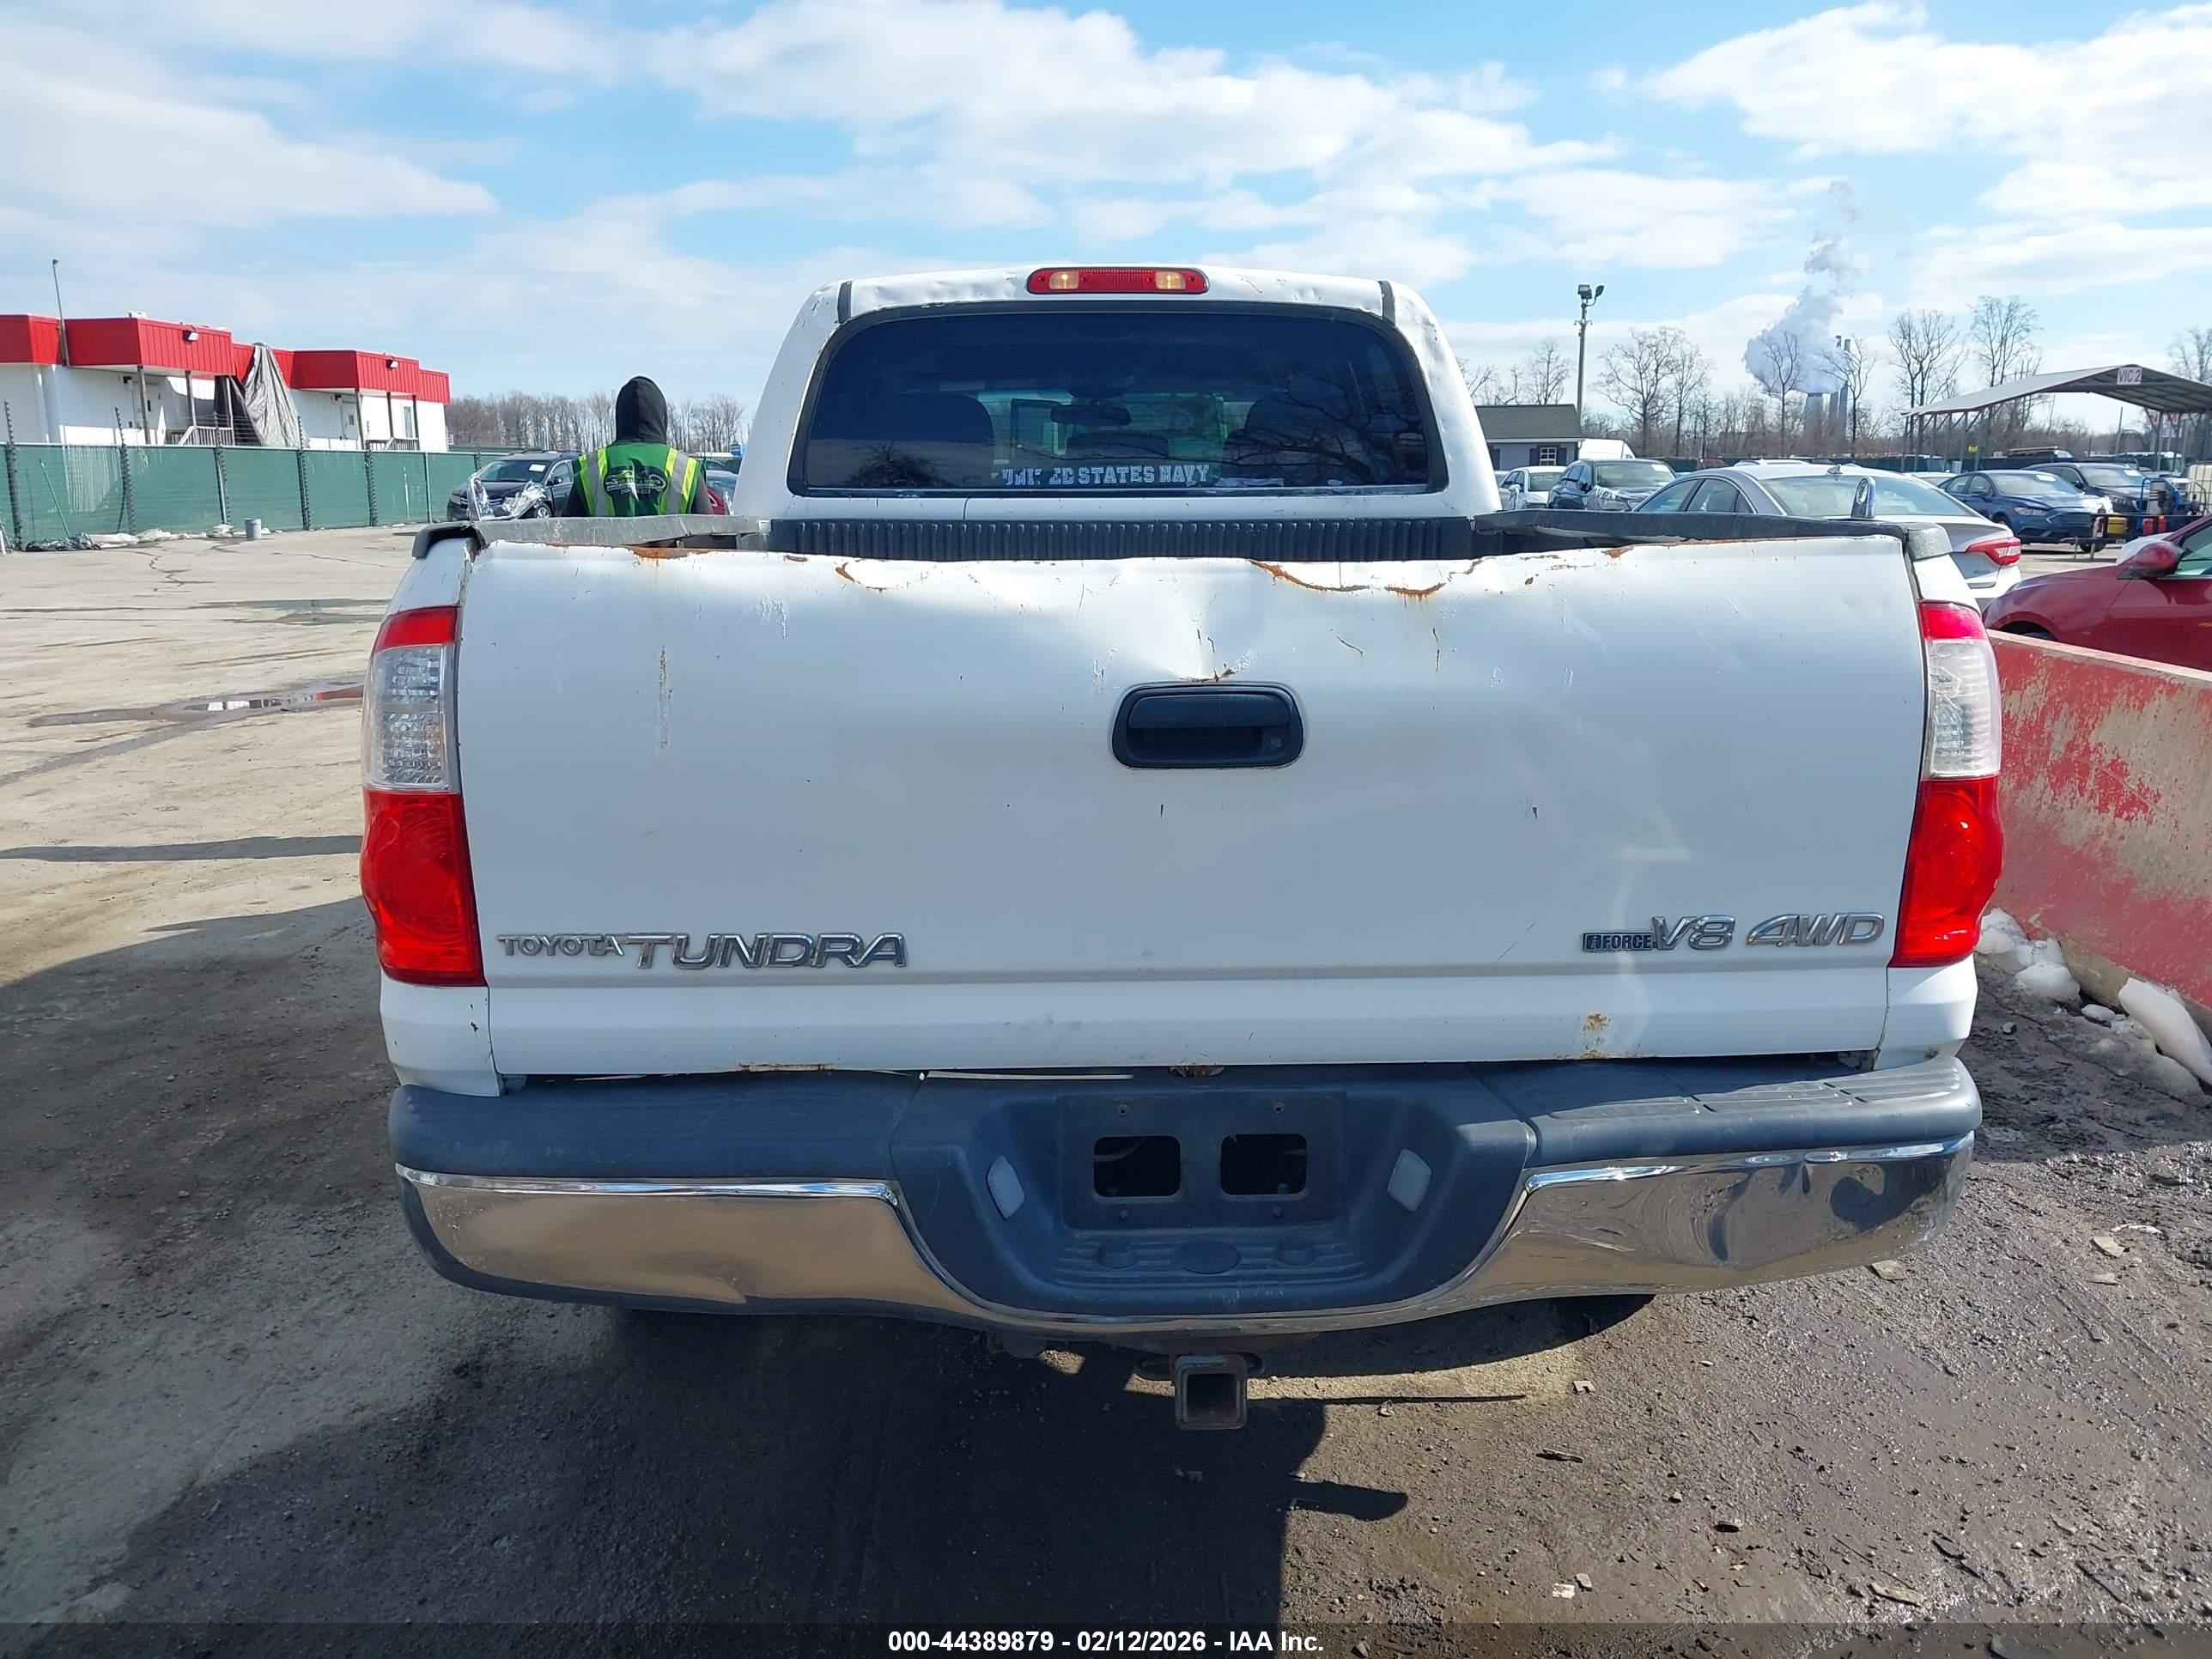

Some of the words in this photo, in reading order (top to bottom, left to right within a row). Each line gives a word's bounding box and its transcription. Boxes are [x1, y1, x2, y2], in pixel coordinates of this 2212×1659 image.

[2118, 369, 2134, 383] VIC
[2134, 369, 2141, 383] 2
[1078, 465, 1155, 485] STATES
[1159, 465, 1210, 483] NAVY
[1652, 915, 1735, 951] V8
[1747, 912, 1885, 948] 4WD
[496, 933, 623, 957] TOYOTA
[625, 933, 907, 969] TUNDRA
